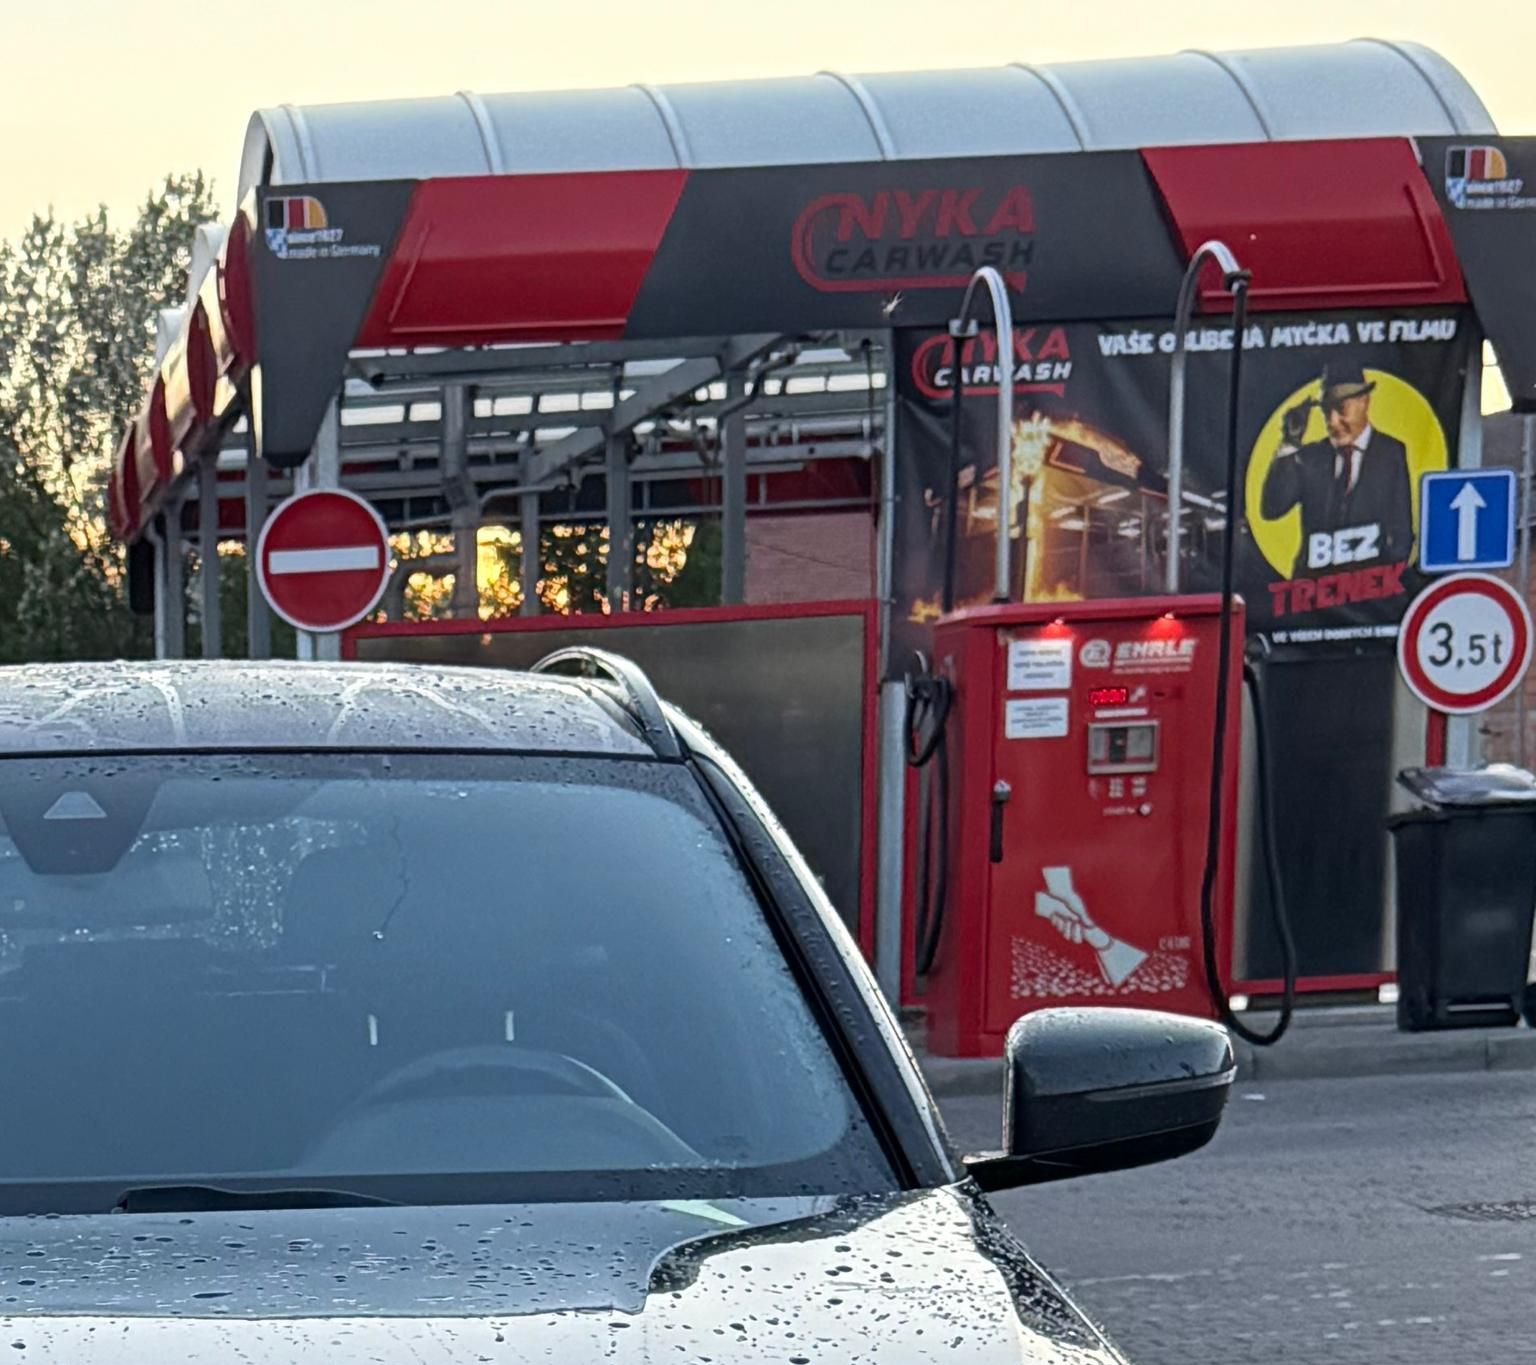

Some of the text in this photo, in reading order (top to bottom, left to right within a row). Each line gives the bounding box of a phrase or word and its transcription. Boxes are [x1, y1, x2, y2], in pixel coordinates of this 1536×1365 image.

[837, 185, 1035, 241] NYKA
[825, 240, 1035, 274] CARWASH
[1098, 330, 1154, 356] VAŠE
[1270, 321, 1351, 348] MYČKA
[1357, 320, 1385, 343] VE
[1389, 319, 1456, 342] FILMU
[1307, 523, 1380, 569] BEZ
[1268, 561, 1408, 617] TRENEK
[1116, 638, 1198, 659] EHRLE
